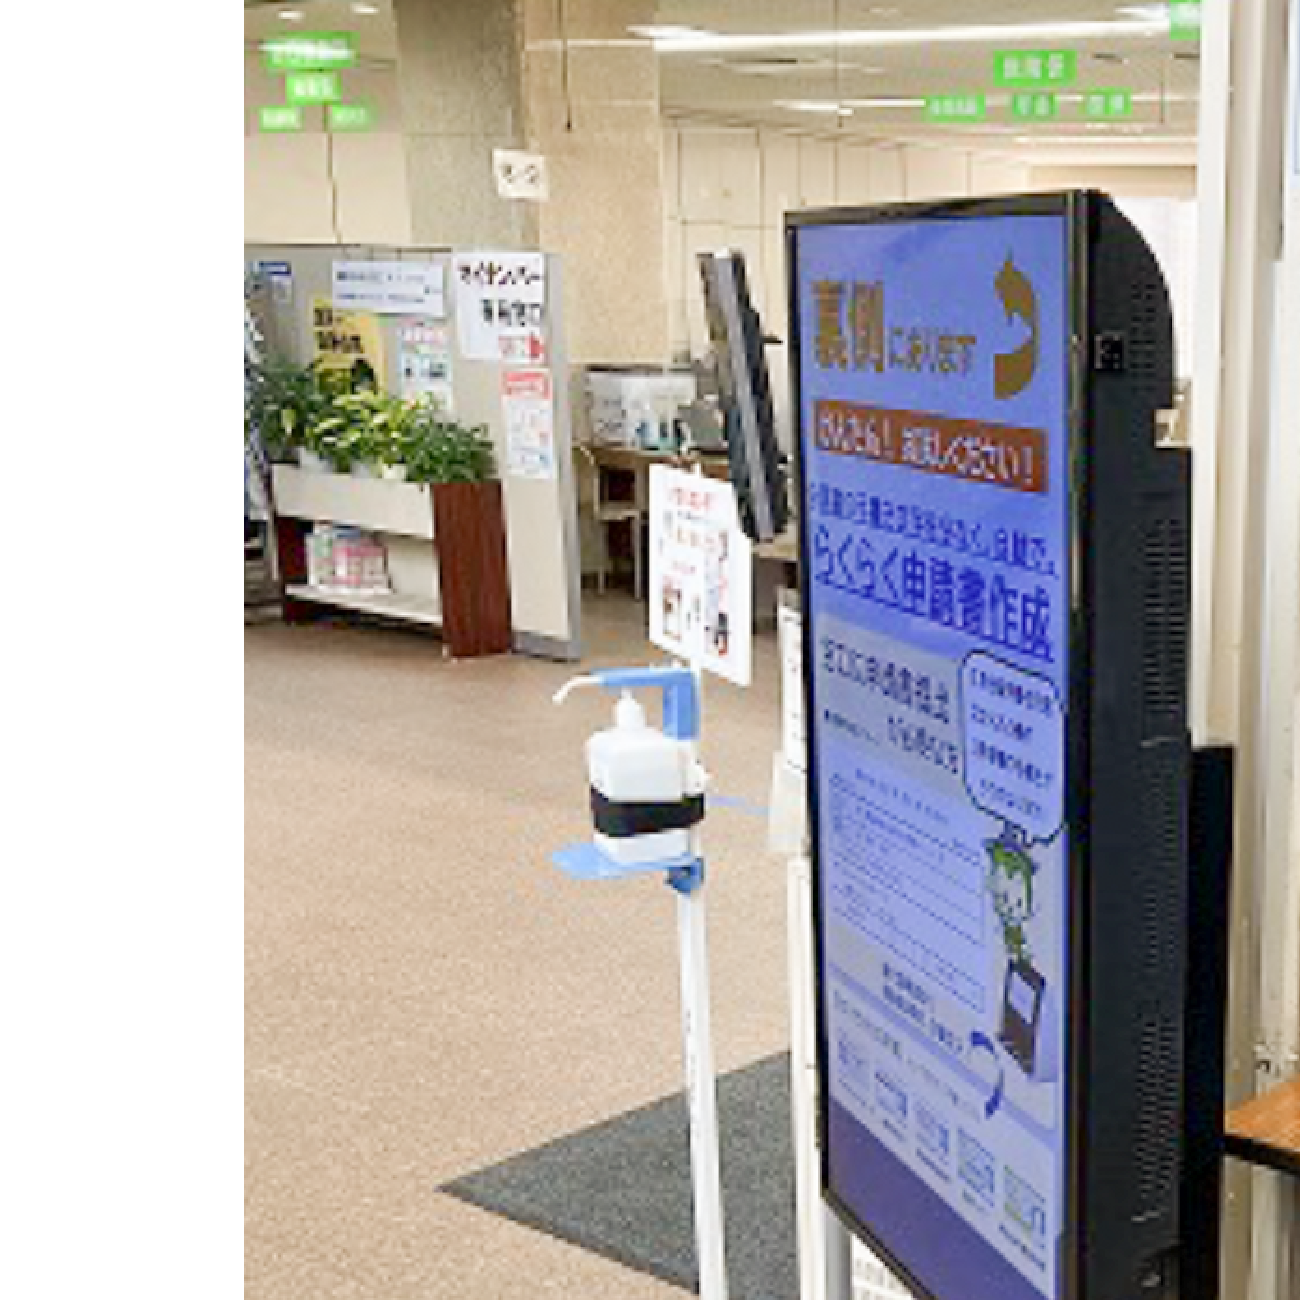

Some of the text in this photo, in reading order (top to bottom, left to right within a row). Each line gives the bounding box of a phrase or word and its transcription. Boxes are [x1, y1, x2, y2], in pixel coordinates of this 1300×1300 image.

[814, 523, 1055, 662] らくらく申請書作成
